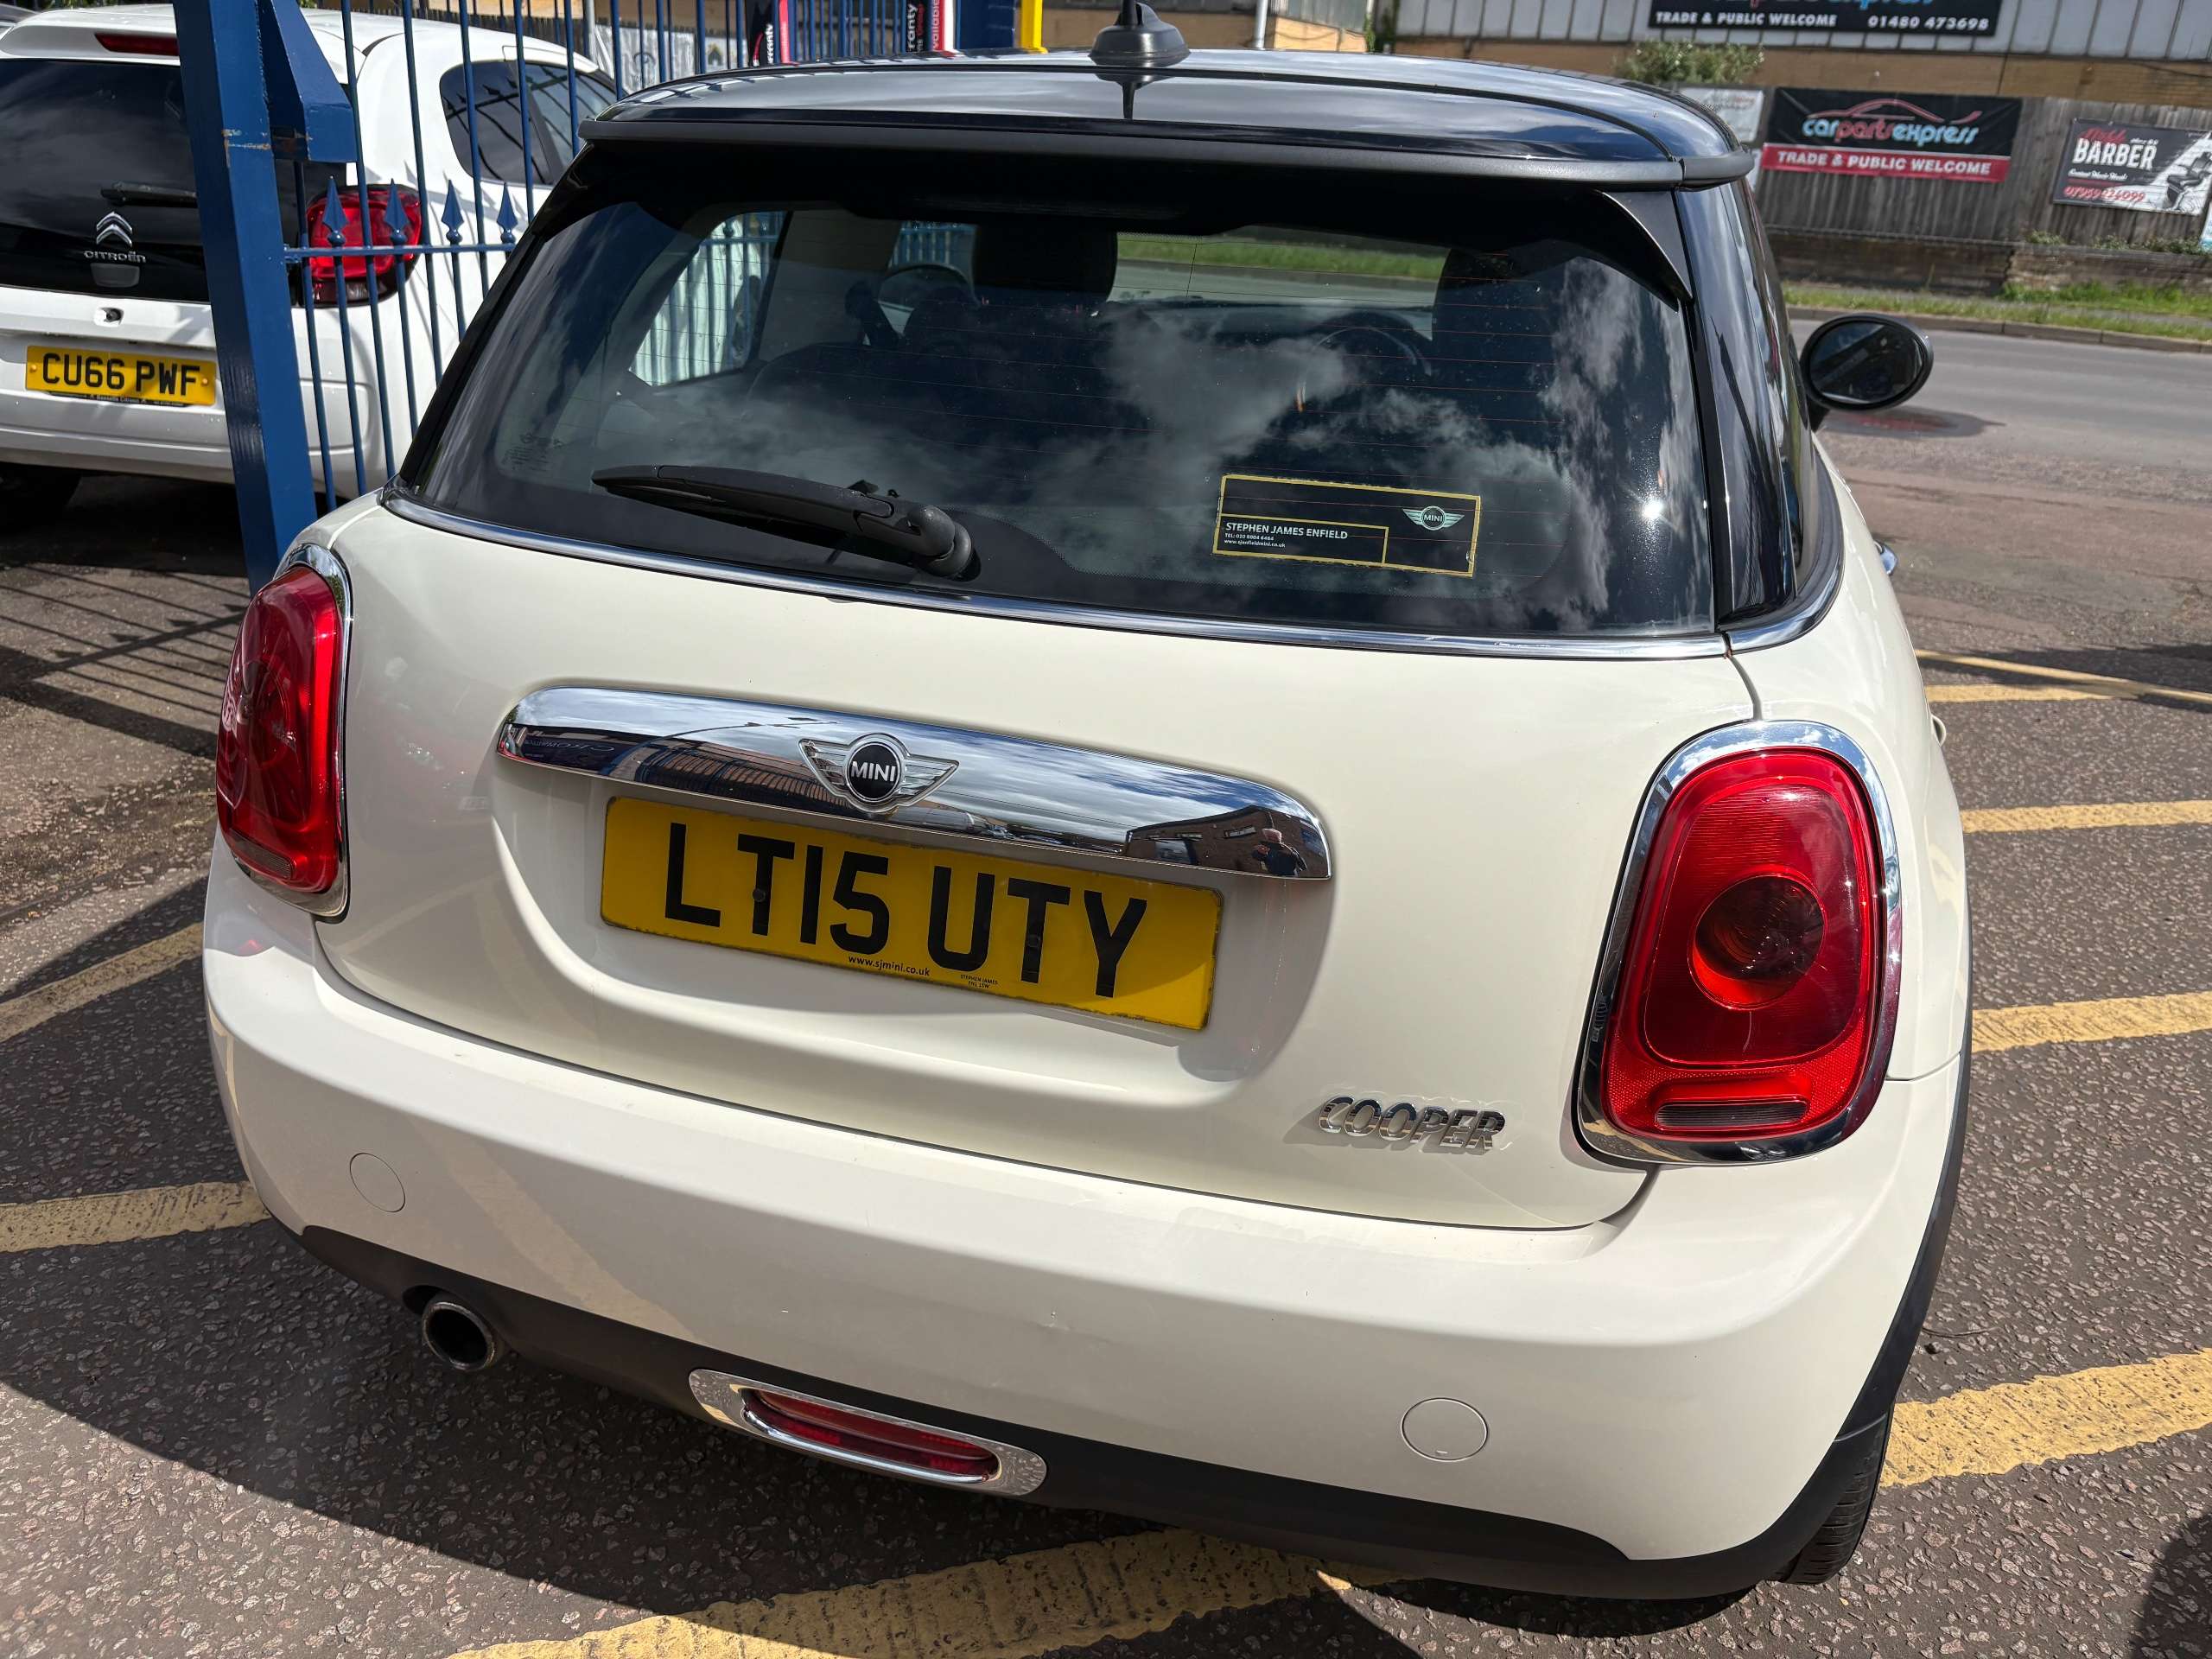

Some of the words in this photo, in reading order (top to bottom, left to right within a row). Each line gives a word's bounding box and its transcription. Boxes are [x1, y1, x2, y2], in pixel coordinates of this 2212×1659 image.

[1656, 11, 1698, 24] TRADE
[1701, 12, 1713, 24] &
[1717, 12, 1764, 25] PUBLIC
[1769, 13, 1838, 27] WELCOME
[1867, 15, 1921, 29] 01480
[1923, 16, 1989, 31] 473698
[1802, 118, 1980, 147] carpartsexpress
[1777, 150, 1827, 166] TRADE
[1831, 153, 1843, 167] &
[1847, 156, 1904, 171] PUBLIC
[1910, 159, 1992, 175] WELCOME
[2072, 137, 2158, 171] BARBER
[42, 353, 125, 391] CU66
[136, 359, 200, 397] PWF
[1225, 522, 1269, 534] STEPHEN
[1270, 525, 1305, 536] JAMES
[1306, 528, 1348, 539] ENFIELD
[1424, 513, 1443, 523] MINI
[850, 760, 899, 785] MINI
[664, 823, 890, 956] LT15
[927, 866, 1147, 998] UTY
[848, 956, 931, 977] www.sjmini.co.uk
[1319, 1096, 1506, 1149] COOPER
